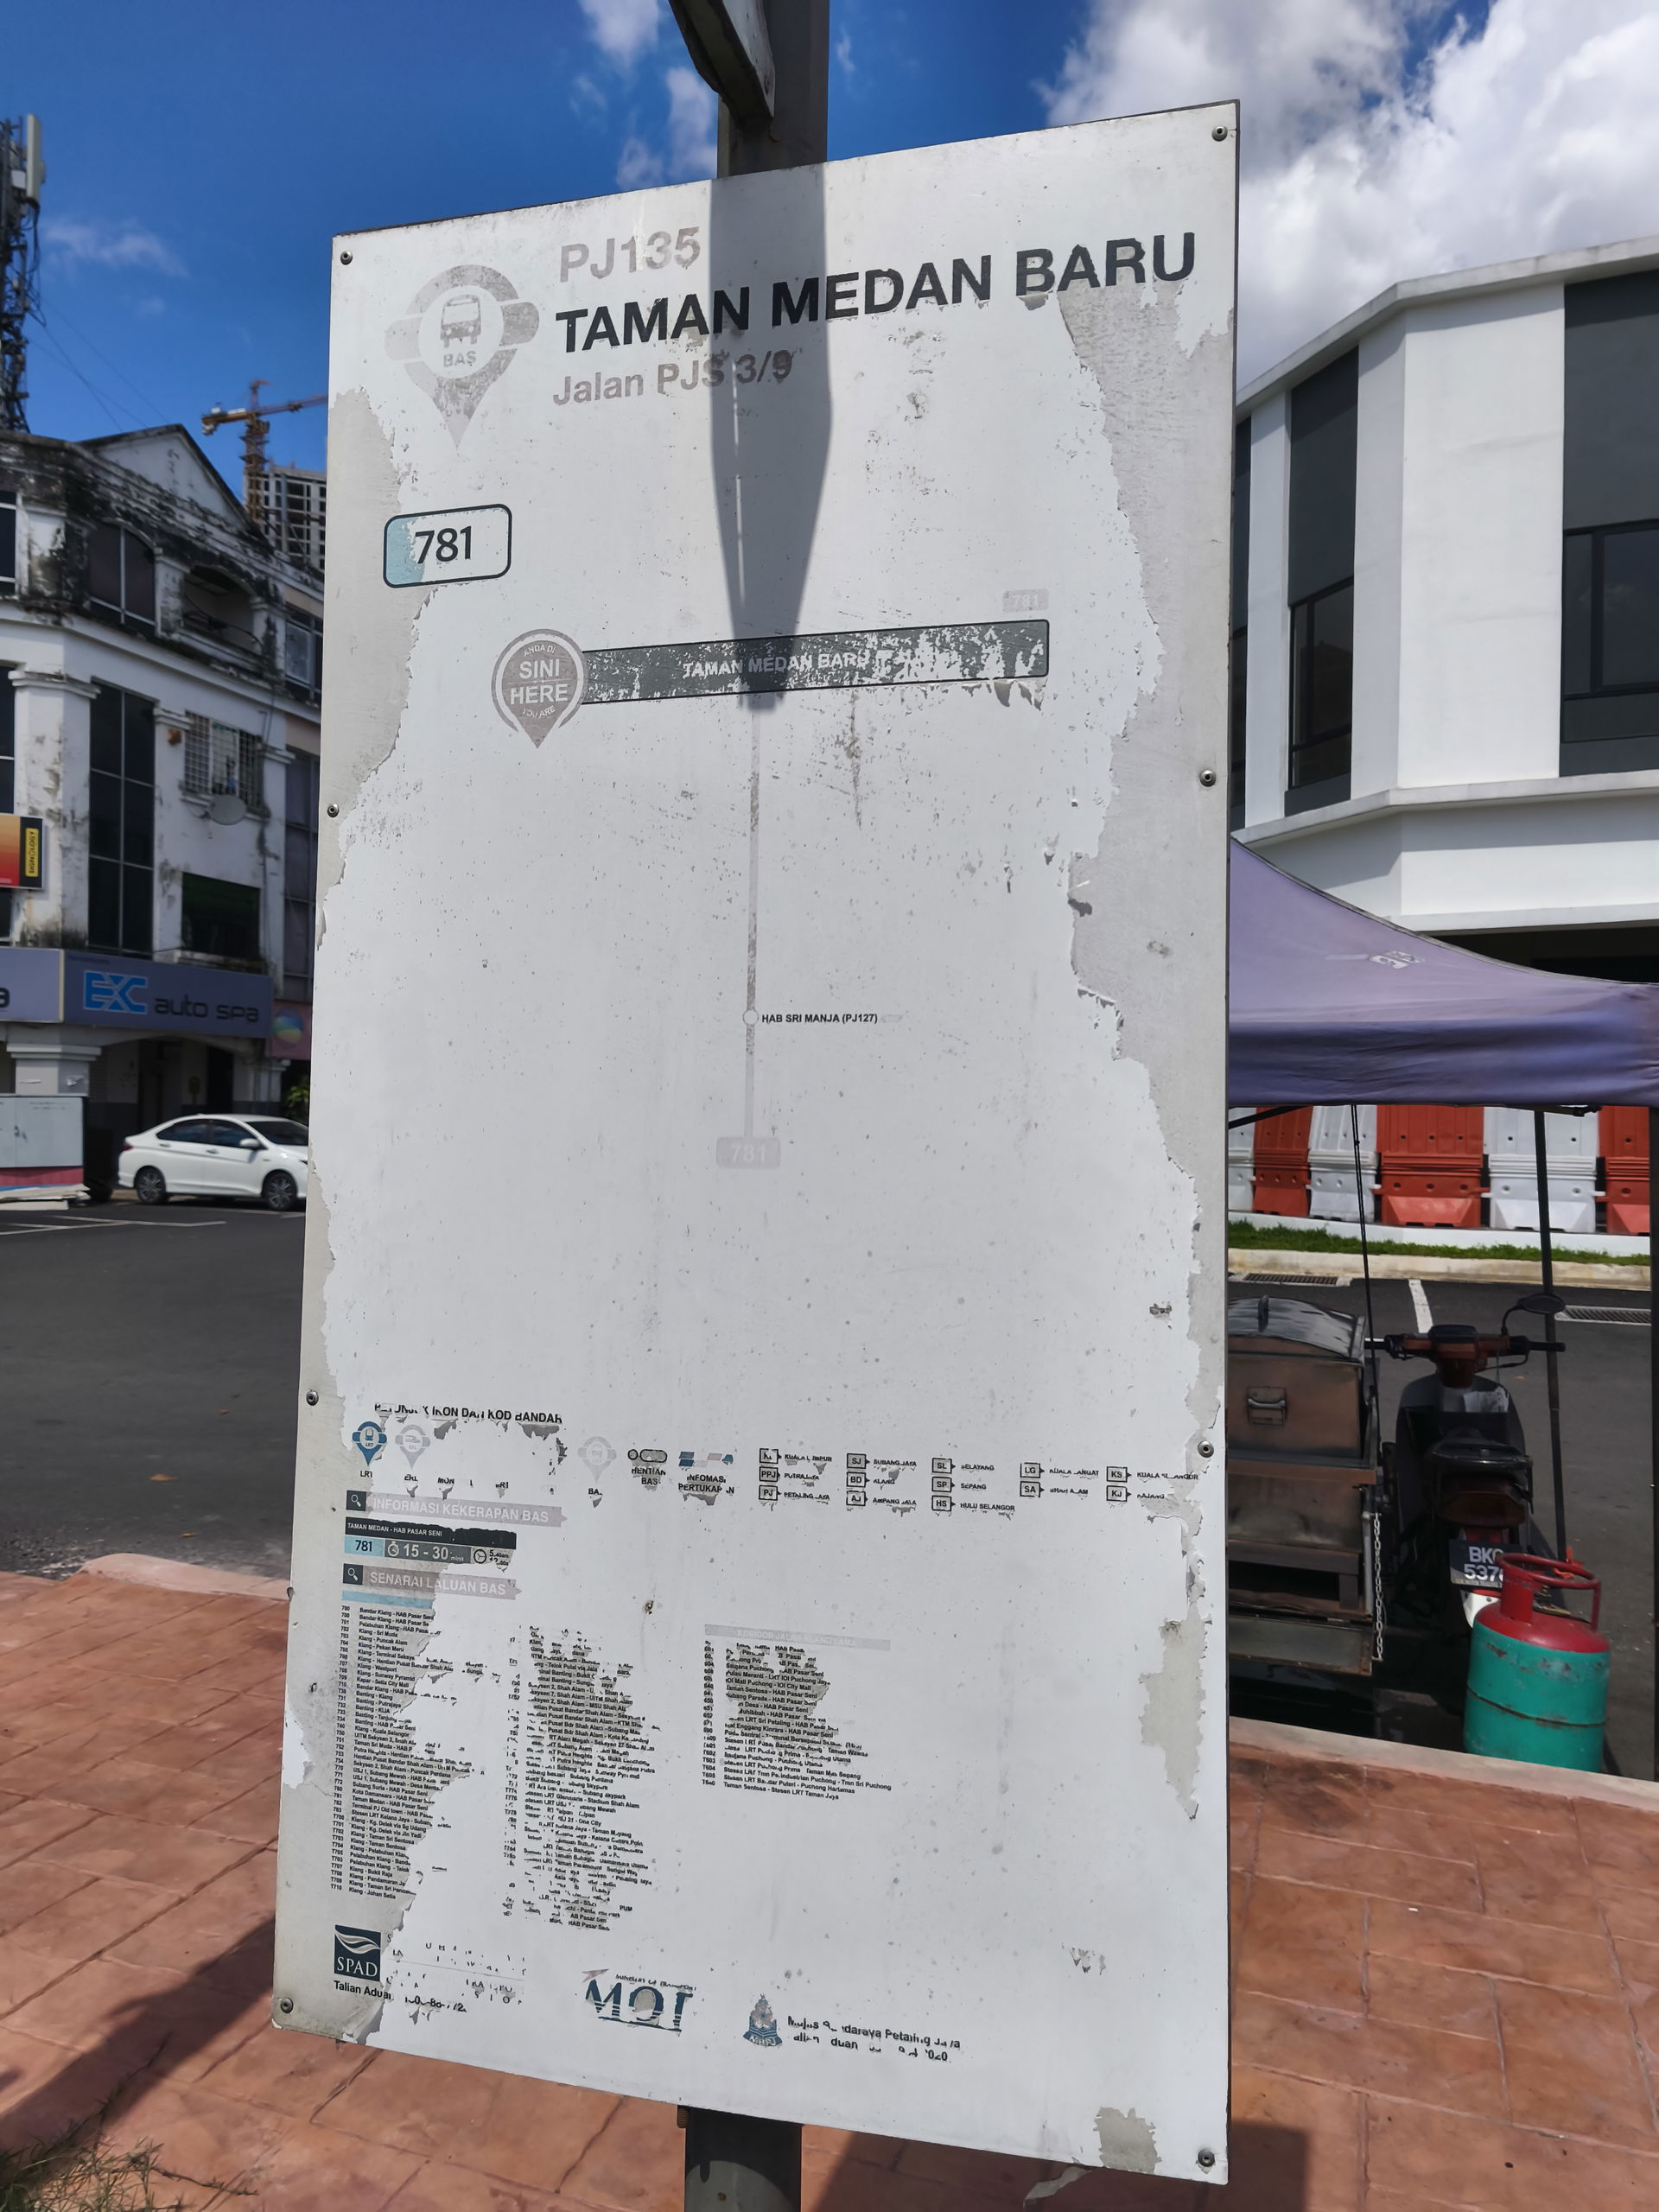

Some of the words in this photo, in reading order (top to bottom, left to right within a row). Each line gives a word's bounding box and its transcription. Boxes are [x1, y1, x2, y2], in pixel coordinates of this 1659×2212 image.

[559, 227, 701, 283] PJ135
[556, 286, 750, 353] TAMAN
[772, 252, 992, 327] MEDAN
[1014, 232, 1196, 298] BARU
[443, 350, 477, 368] BAS
[553, 371, 645, 406] Jalan
[658, 353, 724, 394] PJS
[736, 349, 792, 385] 3/9
[414, 525, 473, 564] 781
[518, 658, 560, 679] SINI
[683, 659, 743, 679] TAMAN
[748, 652, 813, 673] MEDAN
[817, 649, 870, 670] BARU
[510, 683, 569, 705] HERE
[538, 705, 556, 719] ARE
[154, 995, 209, 1018] auto
[216, 1003, 259, 1025] spa
[761, 1014, 783, 1024] HAB
[785, 1014, 802, 1023] SRI
[804, 1014, 840, 1023] MANJA
[842, 1014, 878, 1025] (PJ127)
[729, 1144, 766, 1163] 781
[487, 1409, 512, 1421] KOD
[761, 1470, 776, 1478] PPJ
[373, 1497, 440, 1515] INFORMASI
[442, 1503, 519, 1520] KEKERAPAN
[522, 1510, 550, 1522] BAS
[355, 1539, 372, 1552] 781
[404, 1543, 419, 1558] 15
[432, 1546, 449, 1560] 30
[1464, 1563, 1503, 1582] 537
[370, 1572, 423, 1588] SENARAI
[427, 1574, 477, 1592] LALUAN
[480, 1582, 506, 1596] BAS
[337, 1955, 378, 1977] SPAD
[334, 1980, 361, 1994] Talian
